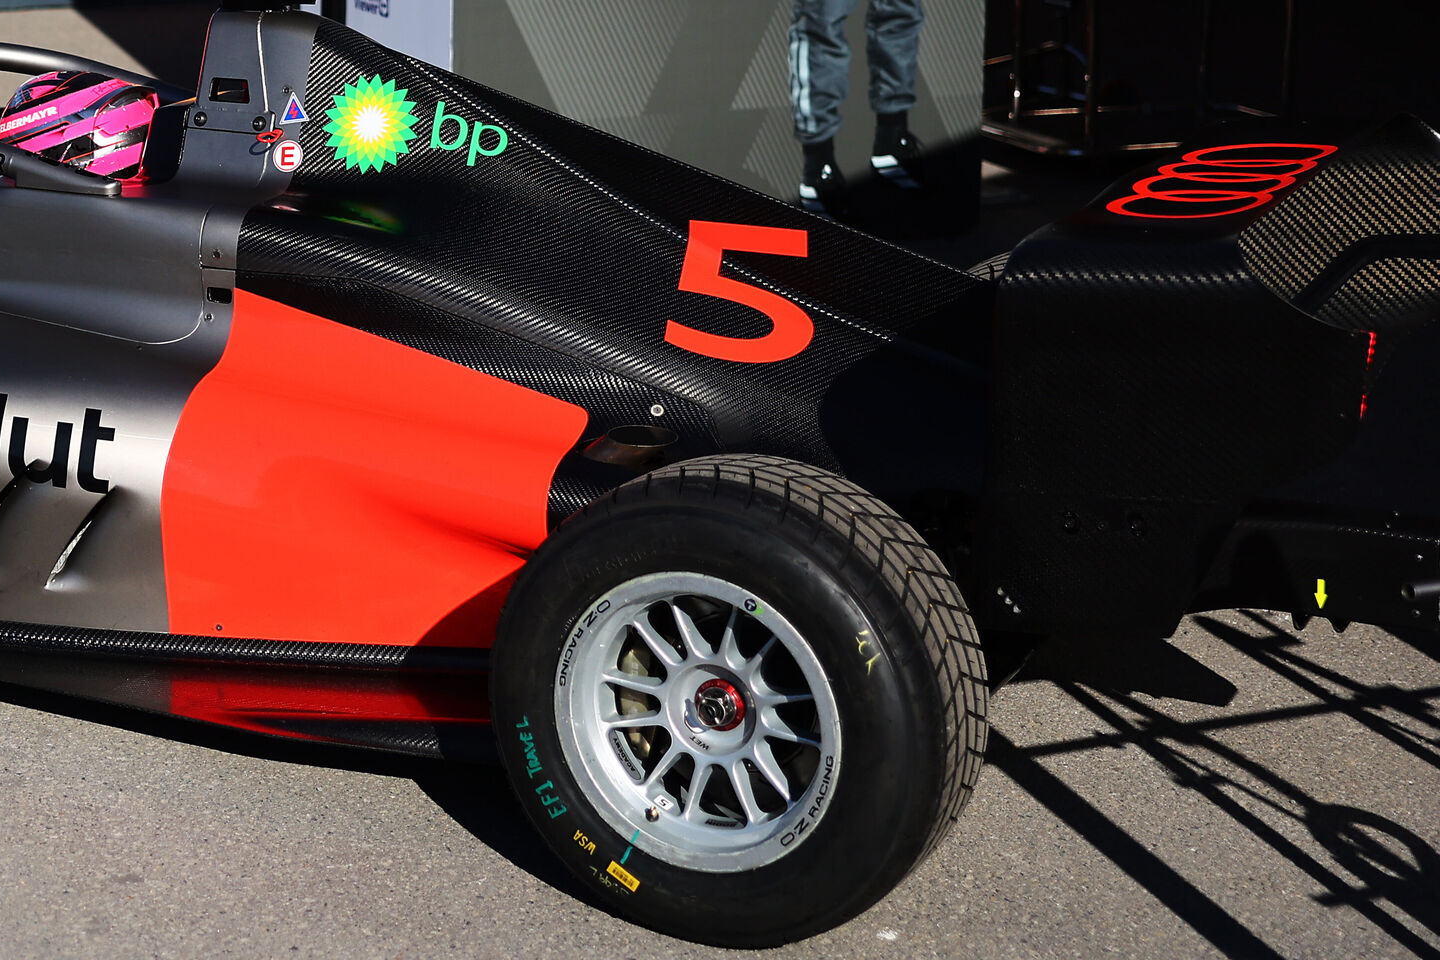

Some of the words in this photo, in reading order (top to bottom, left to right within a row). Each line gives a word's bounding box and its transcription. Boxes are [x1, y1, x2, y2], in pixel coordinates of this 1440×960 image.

[280, 146, 296, 166] E
[429, 101, 509, 167] bp
[664, 219, 815, 363] 5
[560, 627, 585, 687] RACING
[516, 714, 544, 779] TRAVEL
[612, 737, 636, 773] ACADEMY
[689, 735, 710, 751] WET
[808, 755, 834, 818] RACING
[573, 828, 597, 856] WSA
